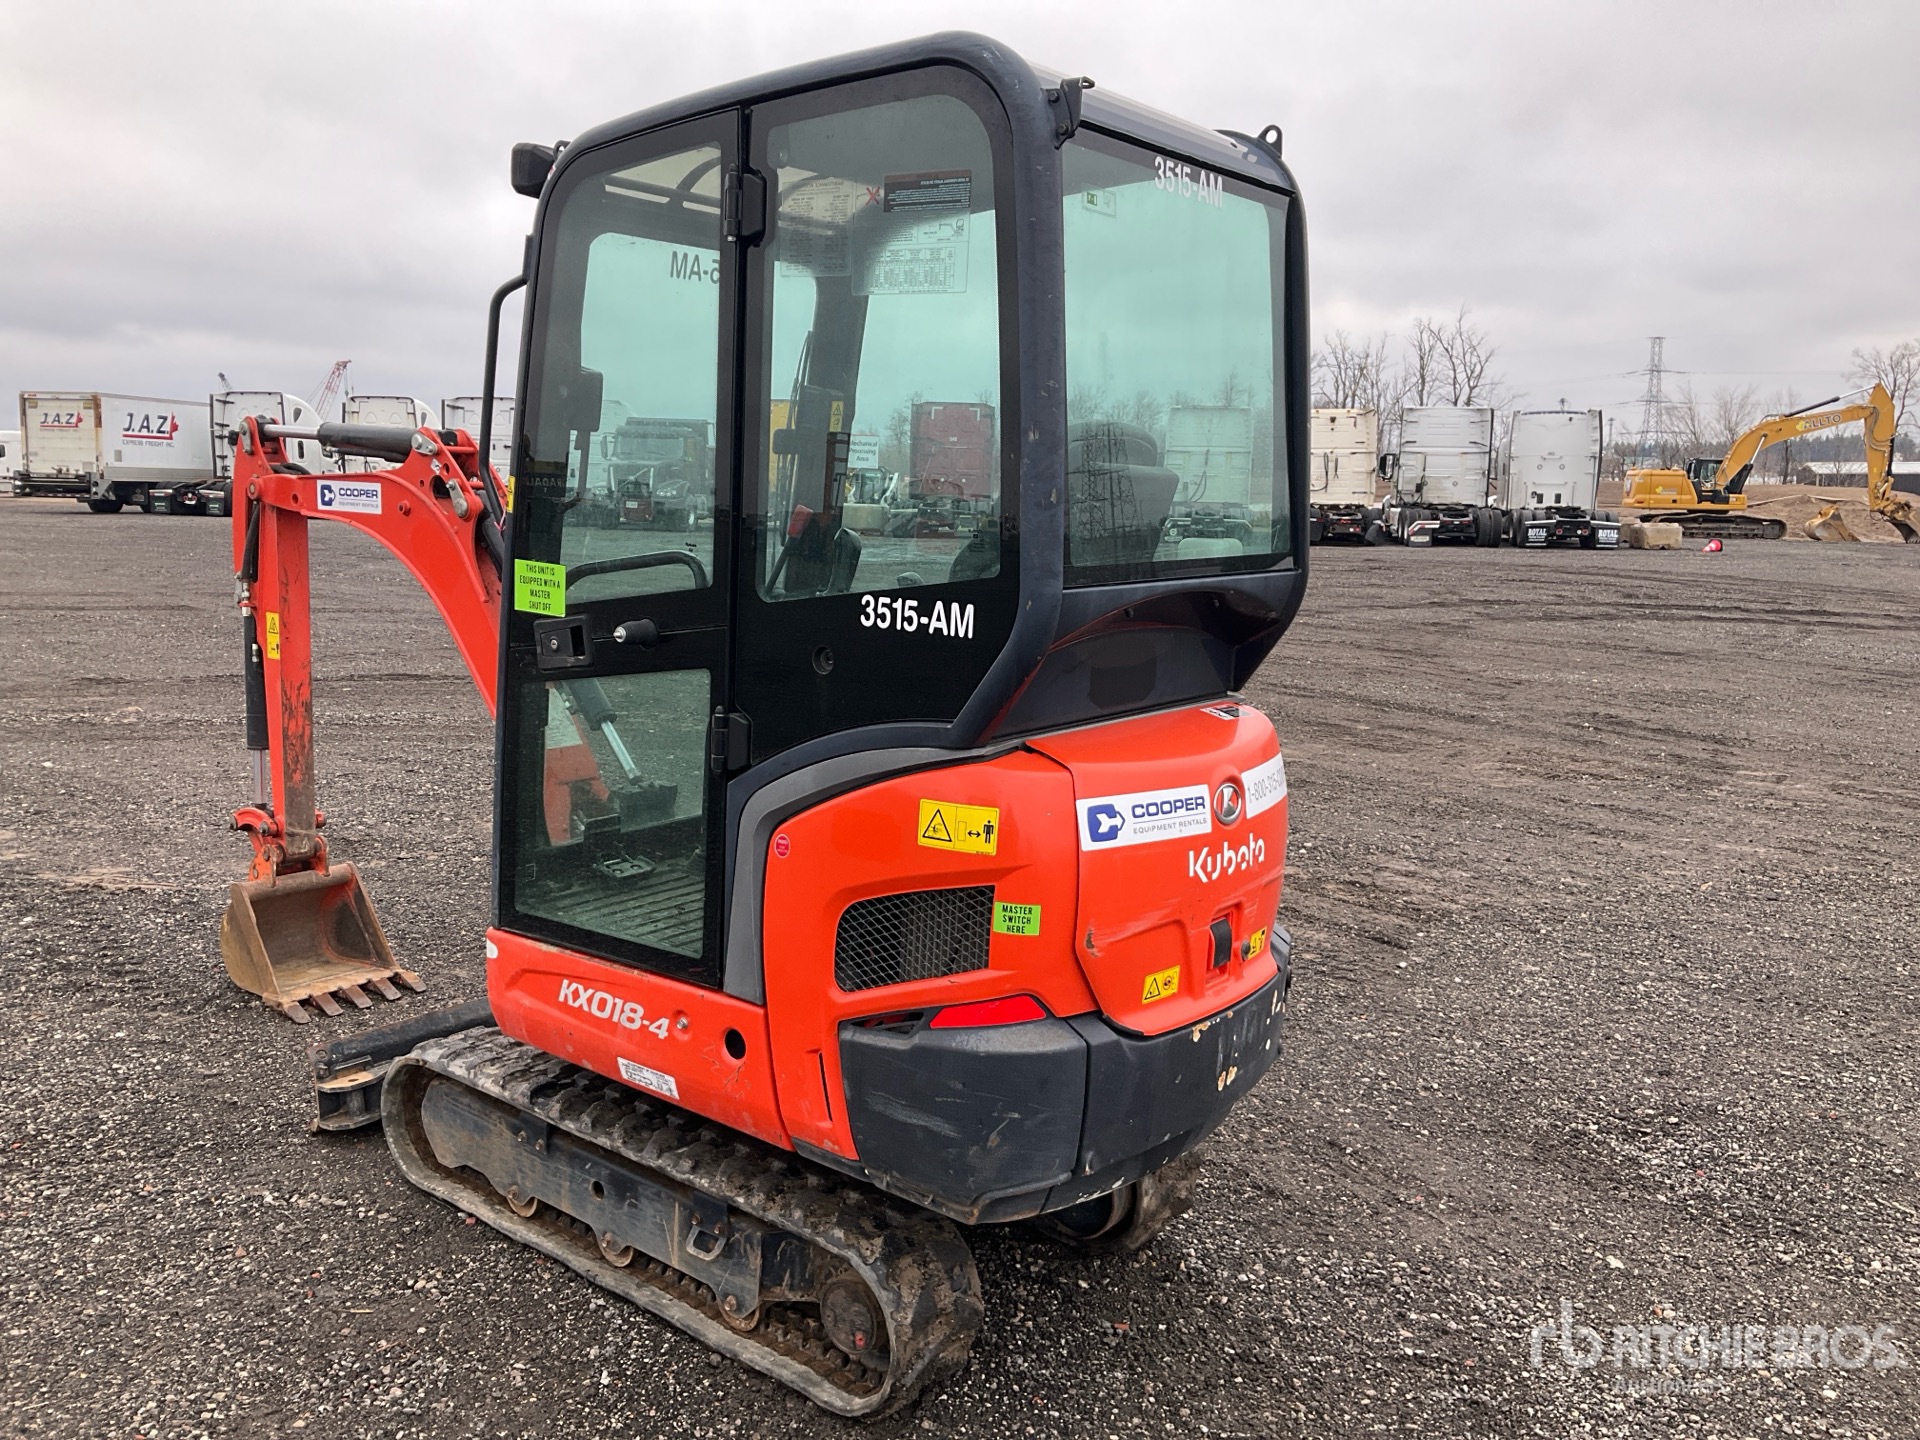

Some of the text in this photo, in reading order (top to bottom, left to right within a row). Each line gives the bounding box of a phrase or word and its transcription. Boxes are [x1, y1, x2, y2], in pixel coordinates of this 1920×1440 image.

[1154, 156, 1223, 208] 3515-AM
[122, 411, 170, 434] J.A.Z.
[338, 487, 379, 499] COOPER
[1527, 528, 1547, 537] ROYAL
[1598, 529, 1619, 538] ROYAL
[526, 564, 555, 576] THIS UNIT IS
[519, 575, 561, 589] EQUIPPED WITH A
[530, 589, 550, 599] MASTER
[529, 601, 551, 611] SHUT OFF
[860, 594, 975, 639] 3515-AM
[1131, 796, 1206, 819] COOPER
[1133, 817, 1208, 835] EQUIPMENT RENTALS
[1188, 832, 1265, 884] Kubota
[1001, 904, 1033, 915] MASTER
[1002, 914, 1032, 925] SWITCH
[1006, 925, 1026, 934] HERE
[558, 978, 670, 1040] KX018-4
